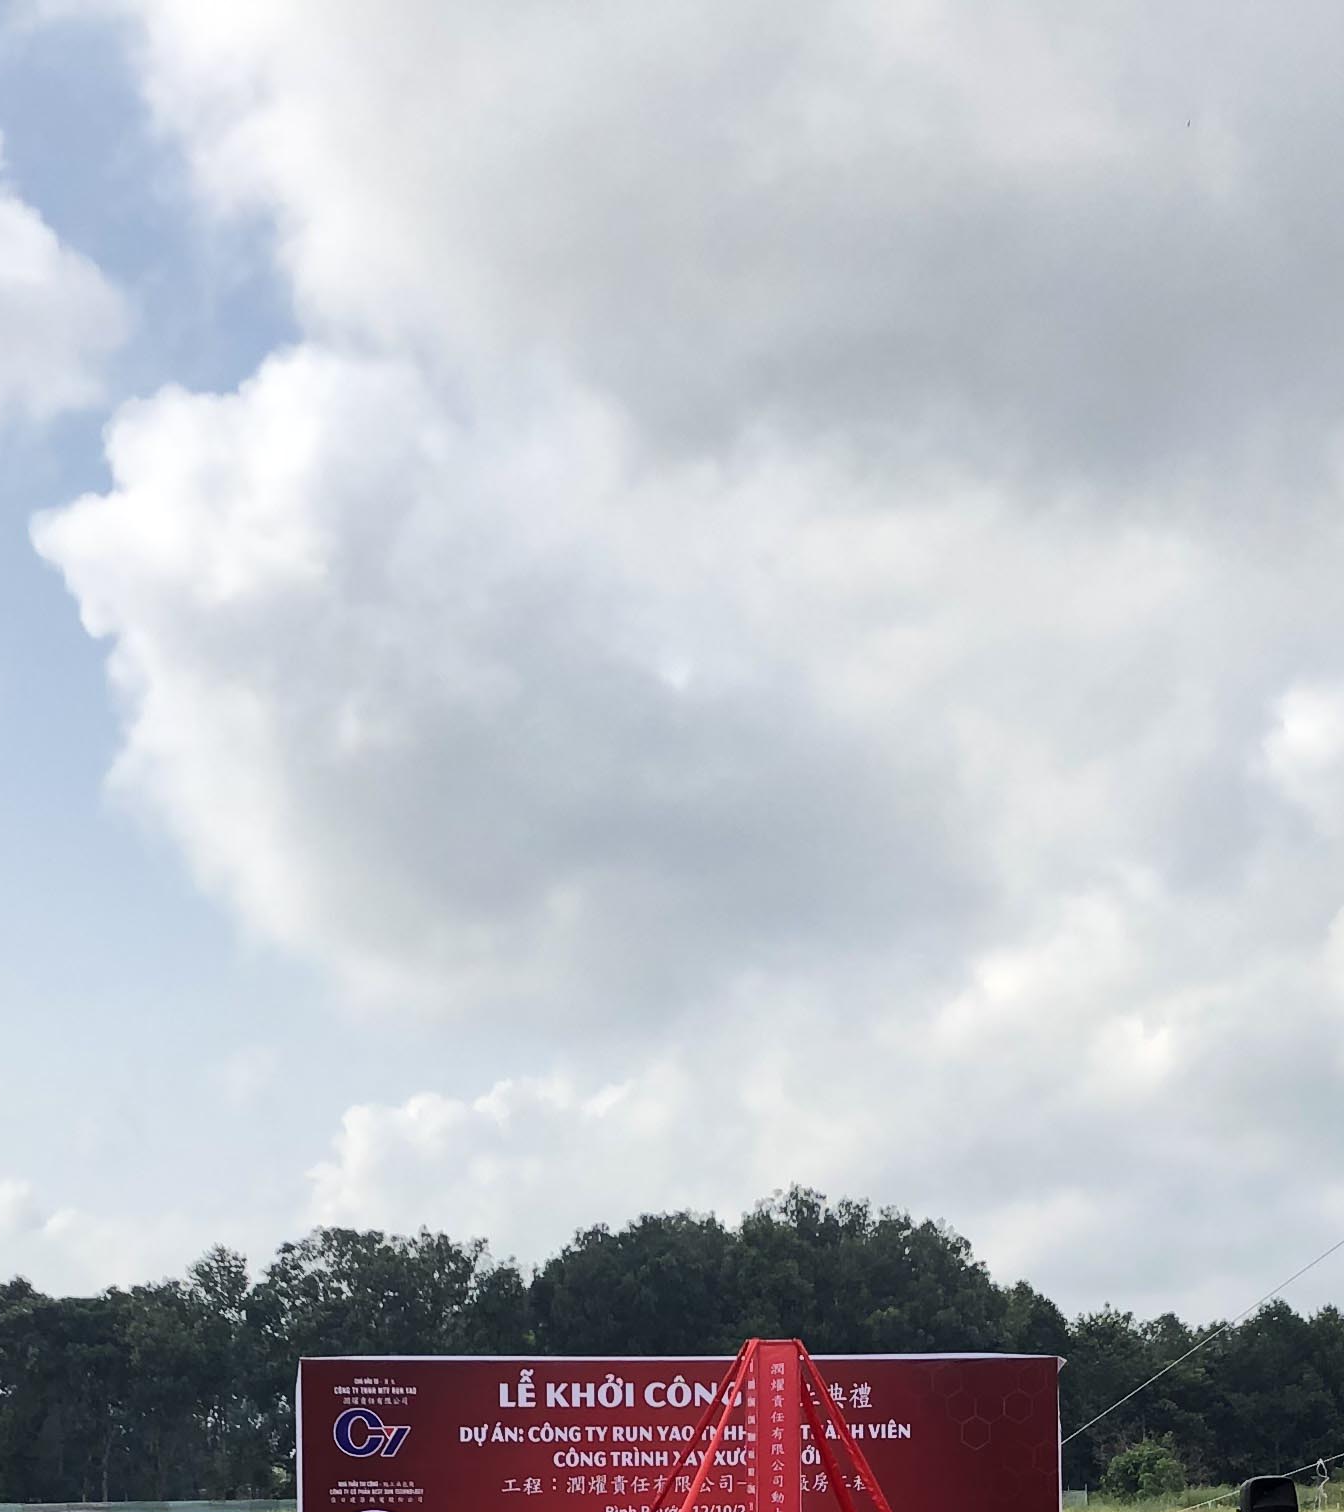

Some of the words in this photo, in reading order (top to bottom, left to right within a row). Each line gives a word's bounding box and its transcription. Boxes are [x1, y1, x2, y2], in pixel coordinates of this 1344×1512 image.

[499, 1368, 536, 1408] LỄ
[546, 1373, 634, 1408] KHỞI
[644, 1375, 743, 1409] CÔNG
[459, 1423, 489, 1446] DỰ
[491, 1421, 524, 1443] ÁN:
[528, 1421, 581, 1443] CÔNG
[585, 1425, 608, 1442] TY
[612, 1425, 652, 1442] RUN
[657, 1425, 695, 1442] YAO
[868, 1418, 911, 1439] VIÊN
[553, 1447, 606, 1468] CÔNG
[610, 1446, 668, 1467] TRÌNH
